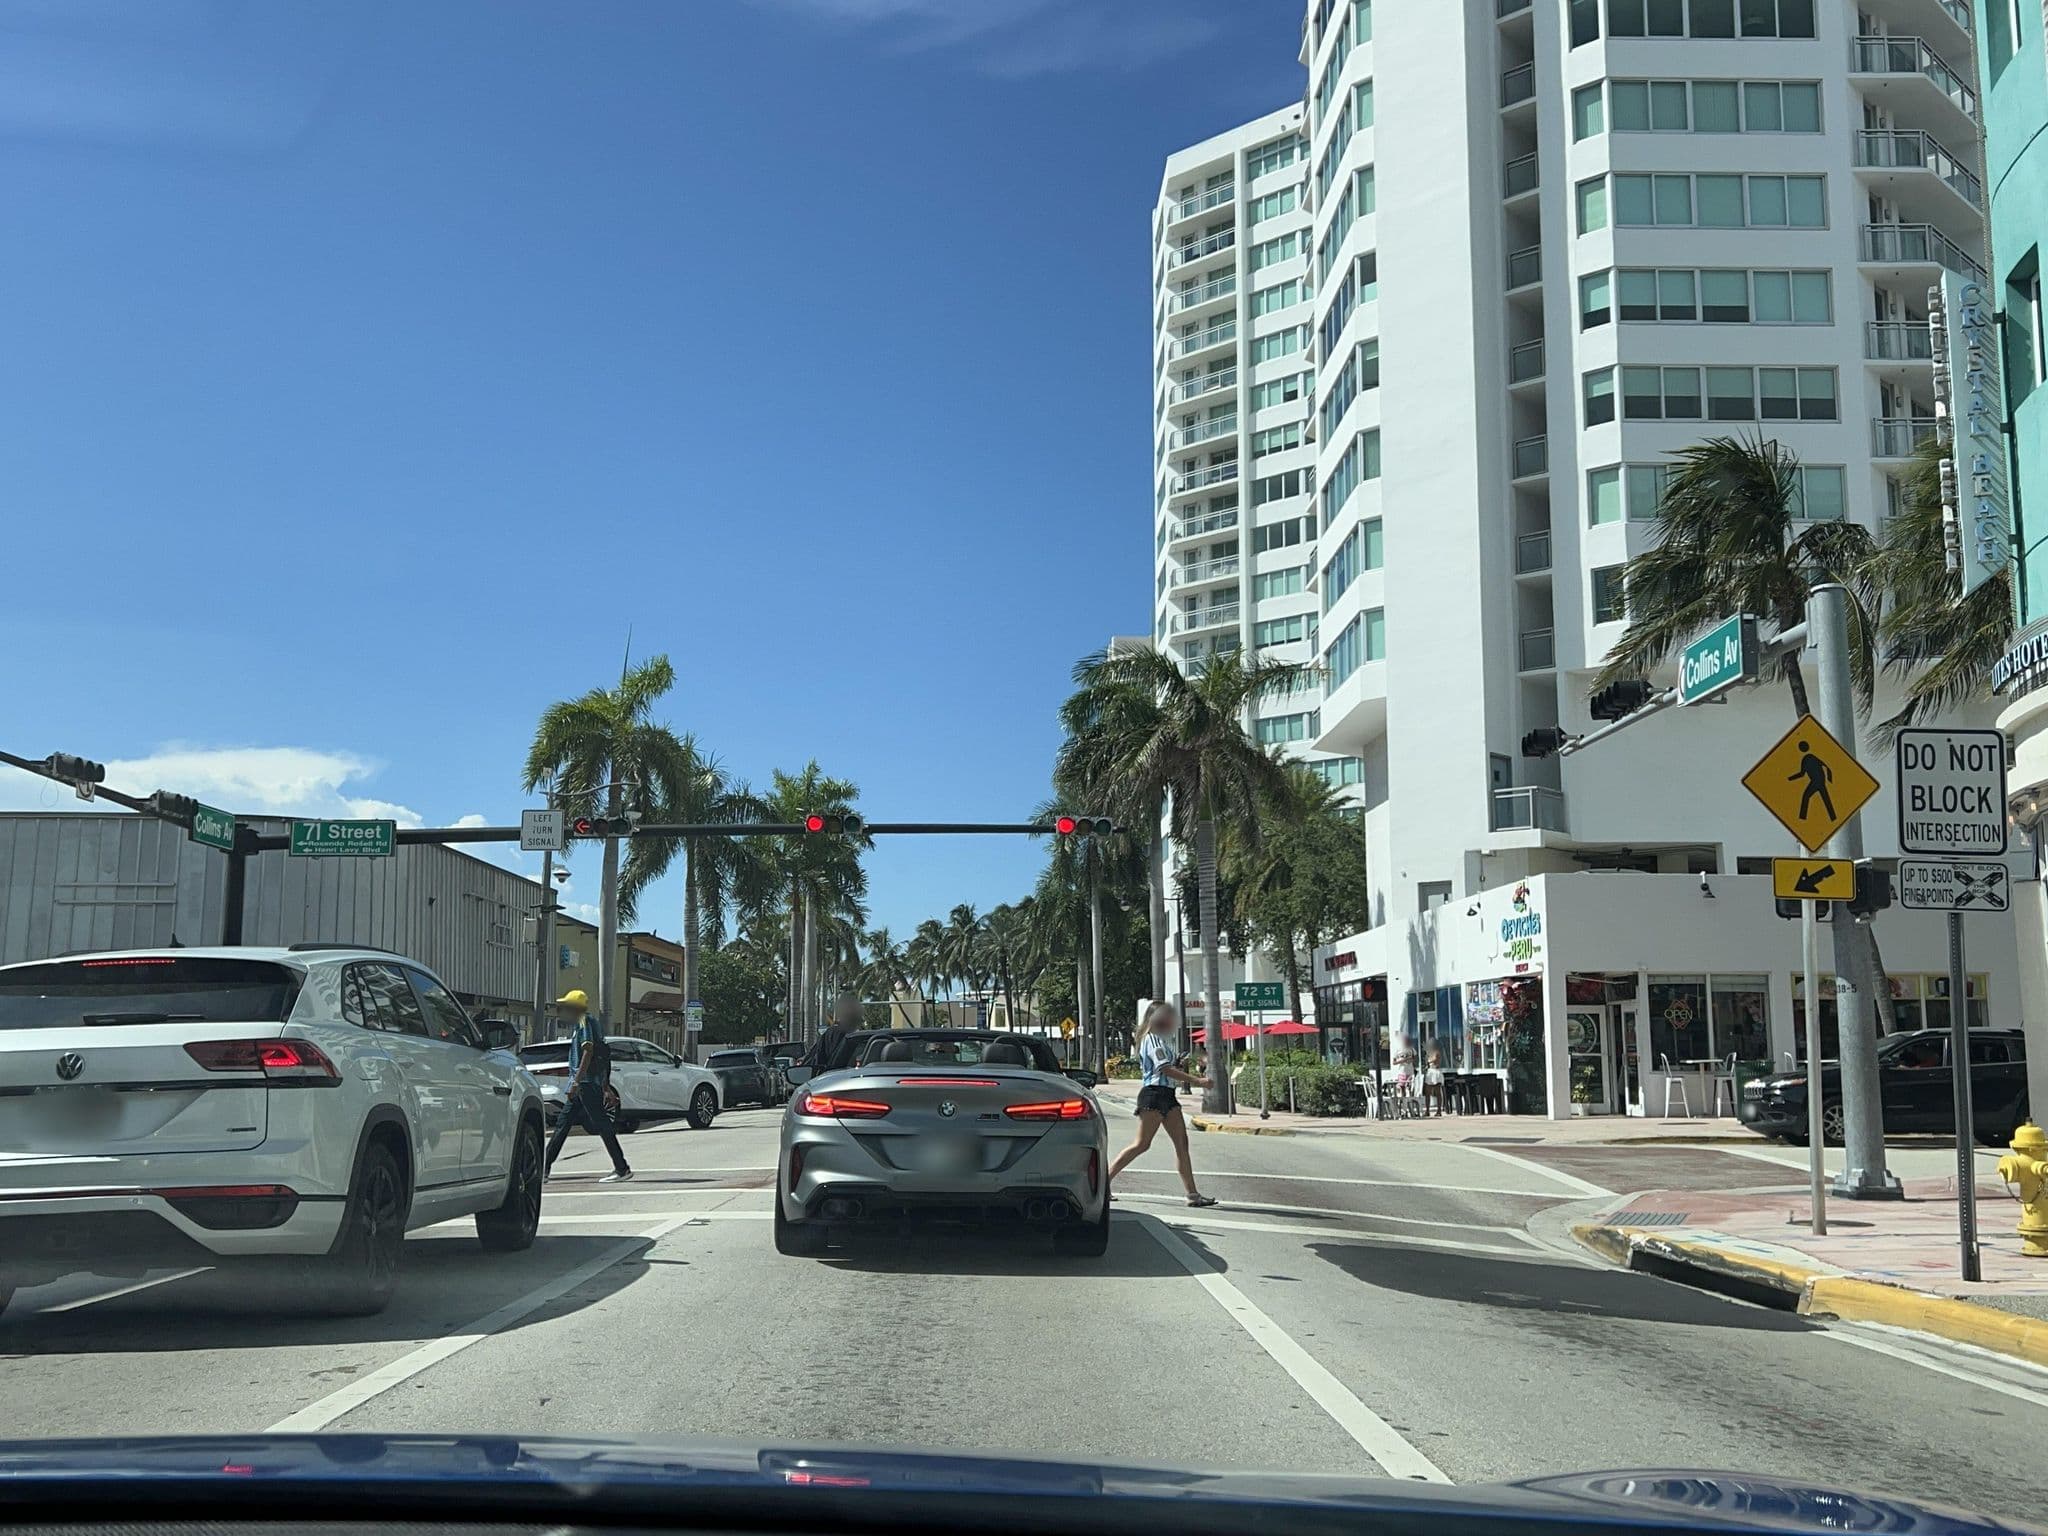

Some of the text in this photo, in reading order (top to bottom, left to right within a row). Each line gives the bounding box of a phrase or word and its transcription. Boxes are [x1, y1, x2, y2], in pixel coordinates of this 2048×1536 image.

[1959, 283, 1991, 437] CRYSTAL
[1971, 454, 2002, 564] BEACH
[1686, 635, 1738, 689] Collins Av
[1904, 743, 1997, 772] DO NOT
[1911, 785, 1993, 814] BLOCK
[195, 812, 233, 841] Collins Av
[533, 814, 552, 822] LEFT
[303, 822, 382, 841] 71 Street
[532, 826, 553, 834] TURN
[1906, 822, 2001, 842] INTERSECTION
[527, 838, 557, 846] SIGNAL
[1904, 868, 1953, 884] UP TO $500
[1511, 938, 1533, 962] PERU
[1241, 986, 1277, 996] 72 ST
[1664, 1008, 1693, 1020] OPEN
